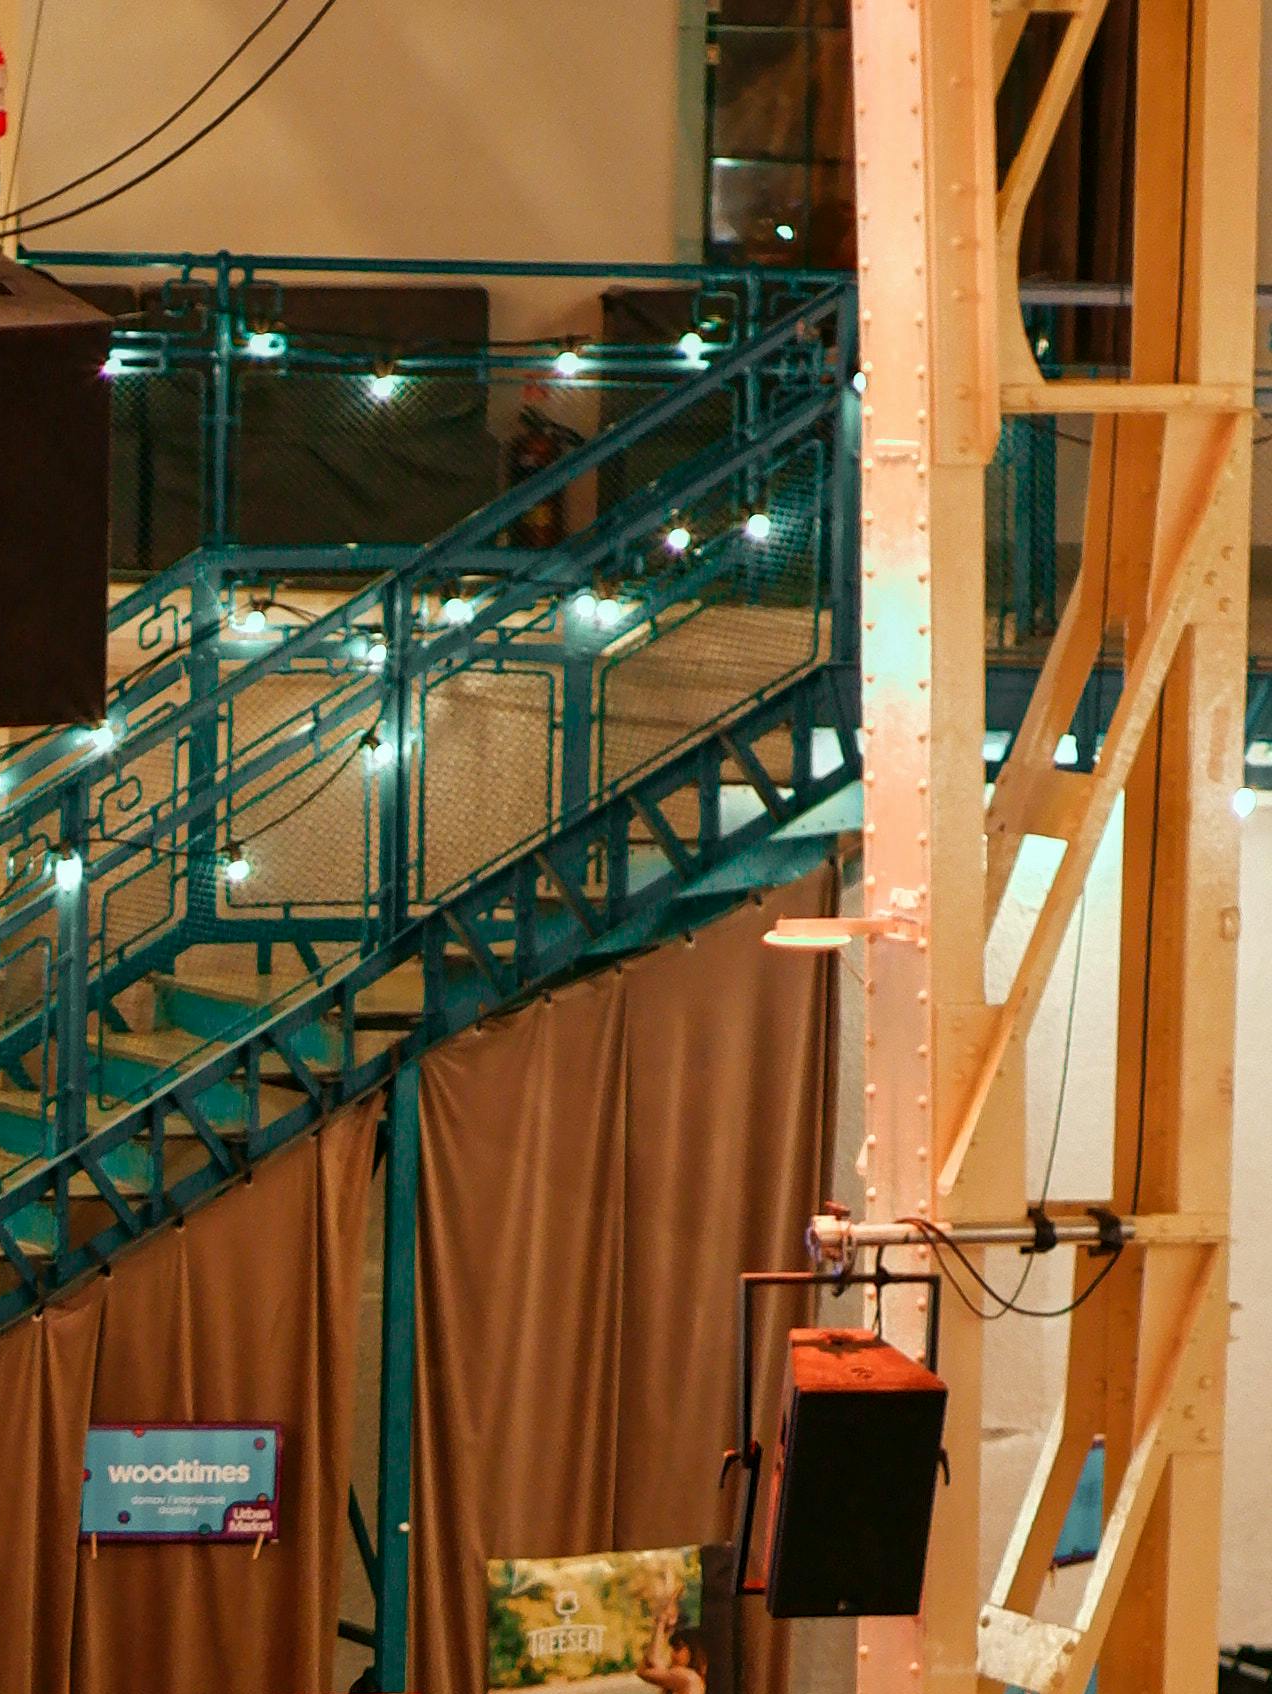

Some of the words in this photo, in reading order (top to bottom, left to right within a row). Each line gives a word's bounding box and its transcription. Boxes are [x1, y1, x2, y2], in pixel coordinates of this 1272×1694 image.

[107, 1458, 251, 1484] woodtimes
[233, 1507, 271, 1520] Urban
[229, 1520, 274, 1533] Market
